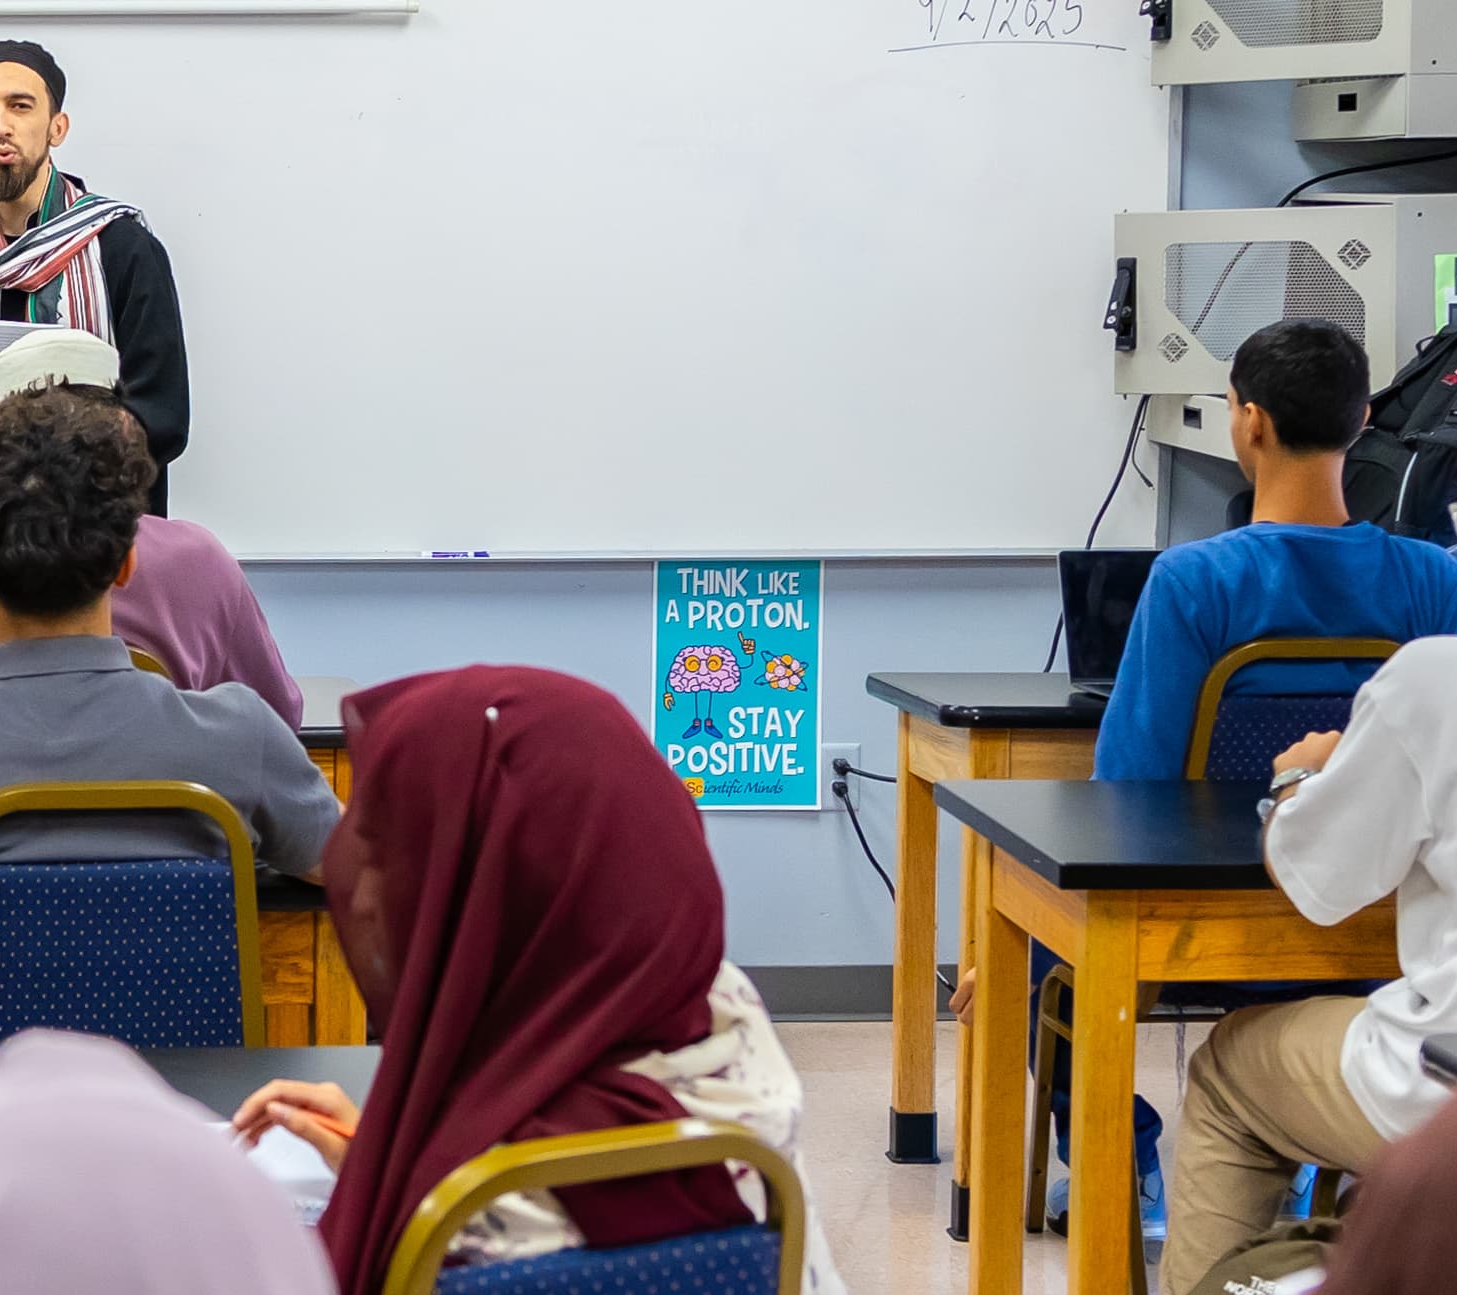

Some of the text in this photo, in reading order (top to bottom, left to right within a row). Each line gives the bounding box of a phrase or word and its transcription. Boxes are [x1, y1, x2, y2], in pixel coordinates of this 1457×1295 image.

[676, 567, 801, 598] THINK LIKE
[664, 599, 810, 631] A PROTON.
[728, 706, 805, 738] STAY
[666, 741, 805, 776] POSITIVE.
[686, 778, 784, 797] Scientific Minds
